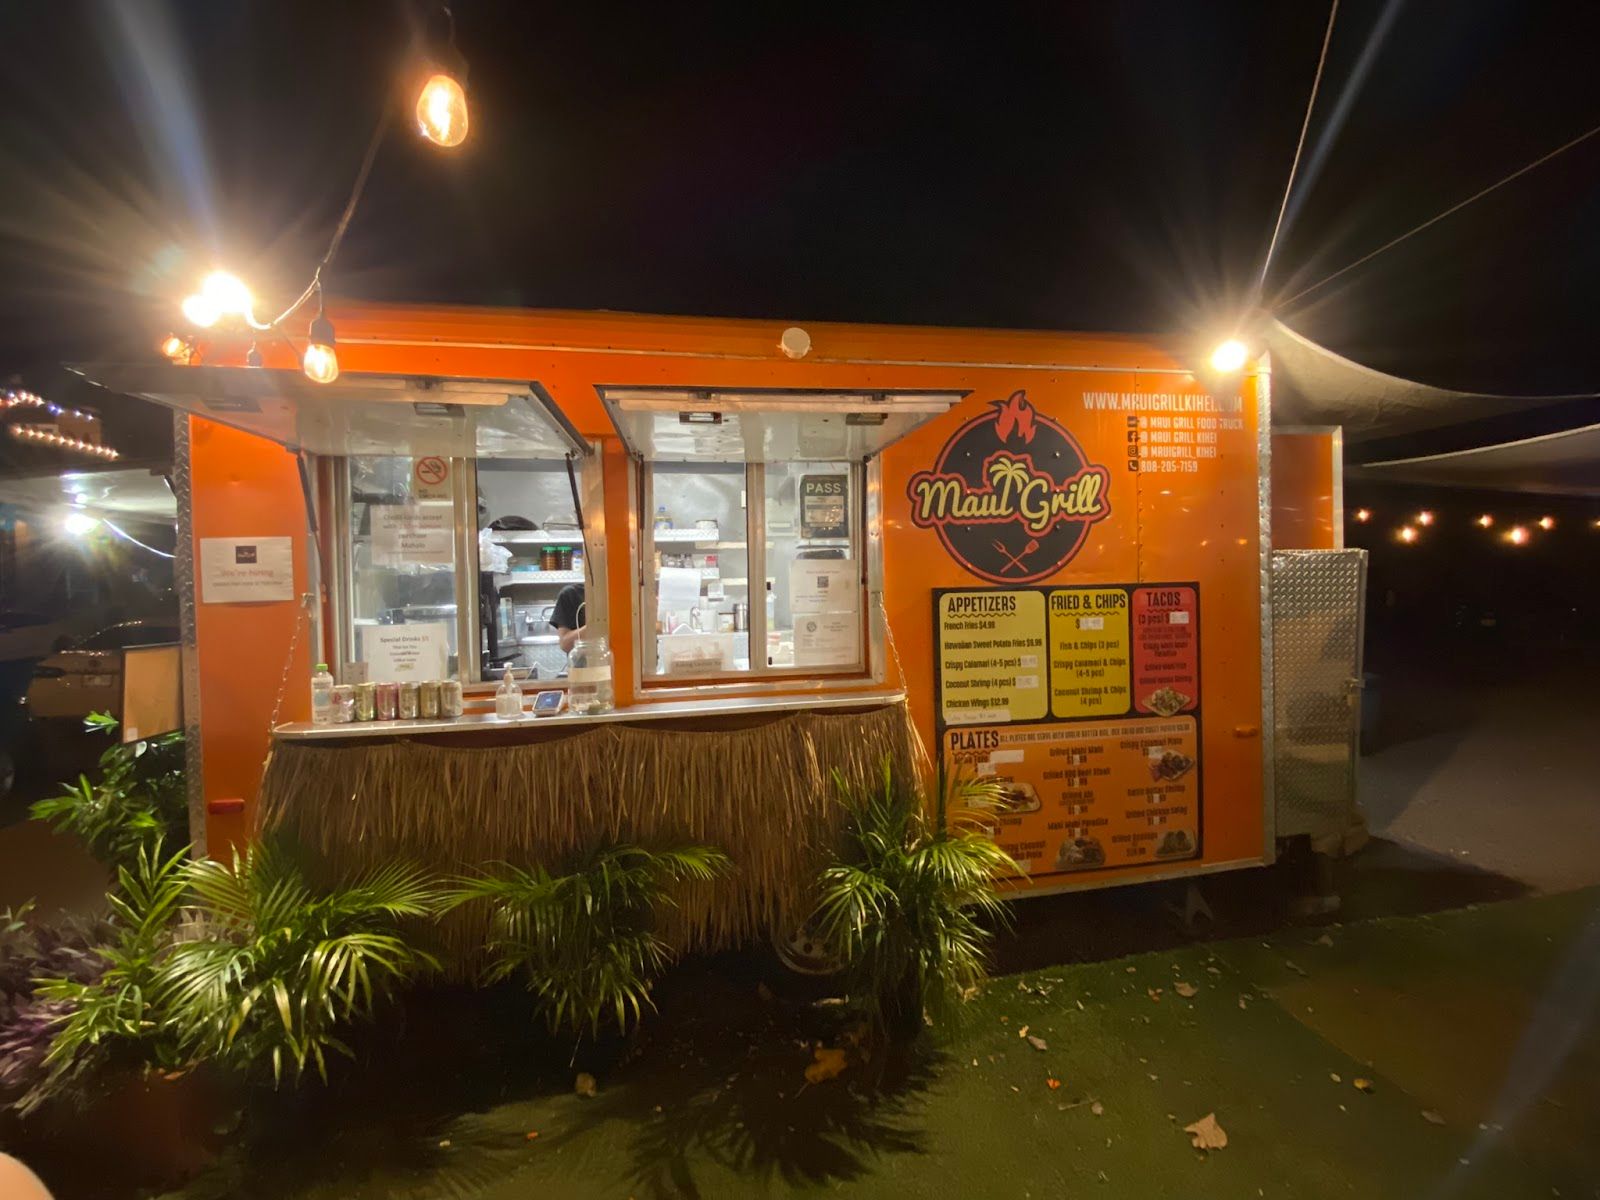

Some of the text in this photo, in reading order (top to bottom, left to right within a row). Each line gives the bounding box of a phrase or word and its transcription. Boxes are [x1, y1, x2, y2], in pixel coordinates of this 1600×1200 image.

[1083, 392, 1242, 412] WWW.MAUIGRILLKIHEI.M
[1151, 416, 1171, 428] MAUI
[1173, 417, 1194, 429] GRILL
[1197, 418, 1216, 430] FOOD
[1151, 431, 1171, 443] MAUI
[1174, 432, 1194, 443] GRILL
[1197, 432, 1217, 443] KIHEI
[806, 483, 841, 494] PASS
[1020, 474, 1102, 529] Grill
[948, 596, 1016, 612] APPETIZERS
[1051, 594, 1126, 610] FRIED & CHIPS
[1146, 592, 1181, 607] TACOS
[944, 622, 963, 630] French
[973, 640, 992, 649] Sweet
[993, 640, 1011, 648] Potato
[945, 661, 963, 670] Crispy
[951, 730, 999, 750] PLATES
